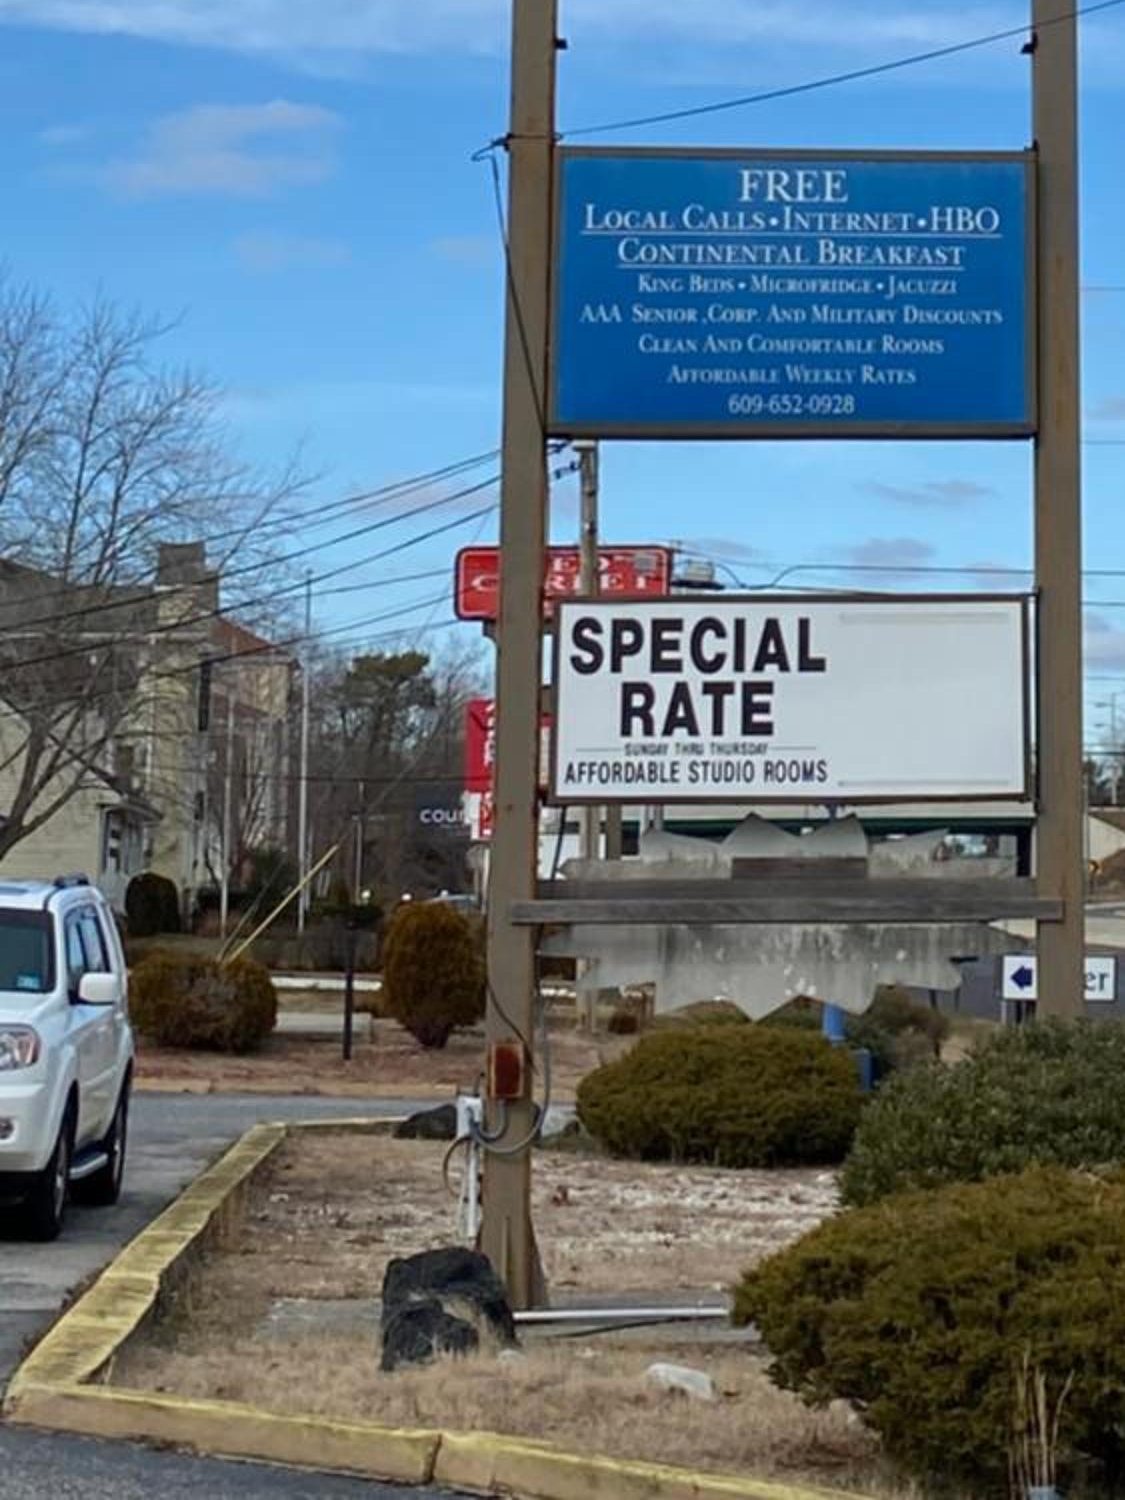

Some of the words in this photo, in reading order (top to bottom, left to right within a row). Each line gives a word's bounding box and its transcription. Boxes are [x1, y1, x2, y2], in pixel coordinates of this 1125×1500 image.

[739, 169, 848, 203] FREE
[584, 204, 674, 230] LOCAL
[682, 205, 766, 231] CALLS
[783, 206, 915, 232] INTERNET
[930, 207, 1000, 233] HBO
[617, 238, 811, 265] CONTINENTAL
[818, 239, 965, 266] BREAKFAST
[637, 273, 684, 293] KING
[689, 273, 735, 293] BEDS
[884, 275, 957, 299] JACUZZI
[579, 304, 622, 323] AAA
[766, 304, 806, 323] AND
[811, 304, 897, 324] MILITARY
[903, 305, 1003, 324] DISCOUNTS
[638, 334, 697, 353] CLEAN
[703, 334, 743, 353] AND
[747, 334, 877, 353] COMFORTABLE
[882, 334, 944, 354] ROOMS
[667, 364, 779, 384] AFFORDABLE
[785, 364, 856, 384] WEEKLY
[861, 364, 916, 385] RATES
[728, 393, 855, 414] 609-652-0928
[569, 616, 827, 675] SPECIAL
[619, 681, 774, 737] RATE
[624, 743, 668, 757] SUNDAY
[710, 743, 768, 756] THURSDAY
[564, 761, 680, 784] AFFORDABLE
[688, 760, 755, 783] STUDIO
[763, 760, 828, 783] ROOMS
